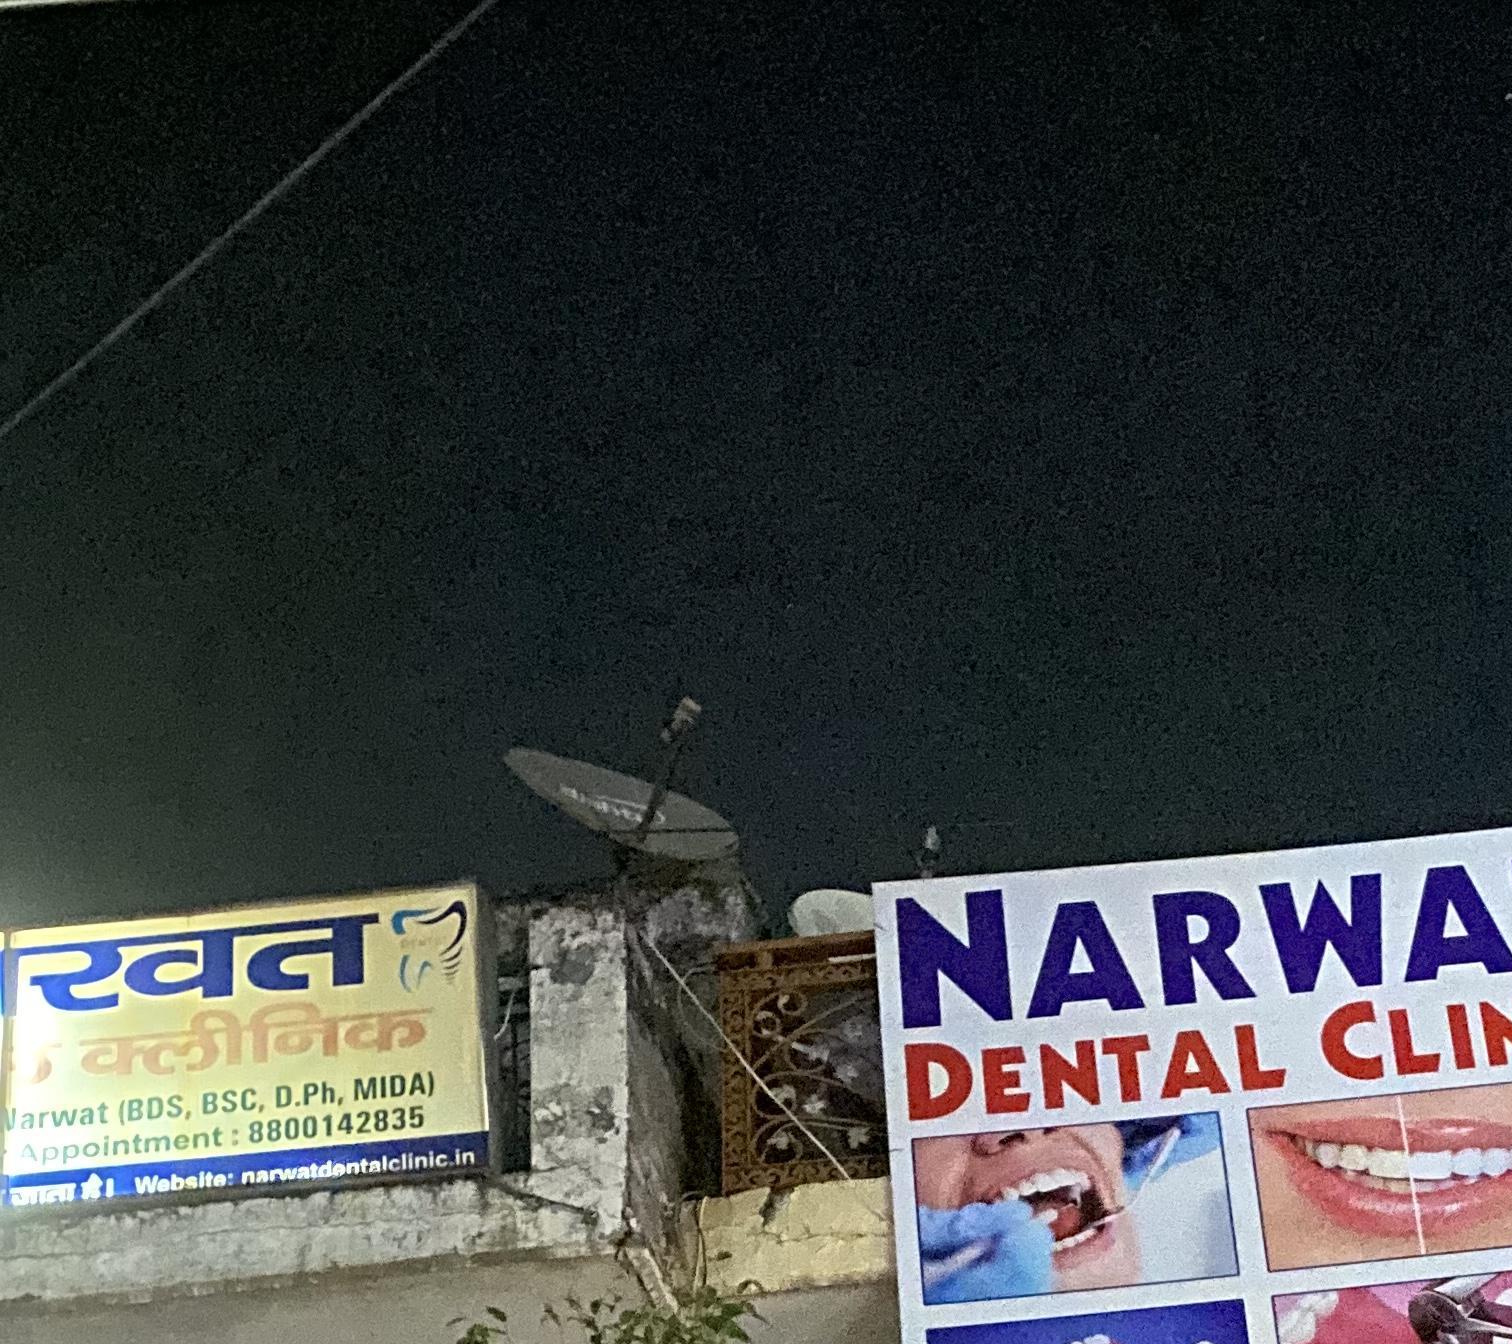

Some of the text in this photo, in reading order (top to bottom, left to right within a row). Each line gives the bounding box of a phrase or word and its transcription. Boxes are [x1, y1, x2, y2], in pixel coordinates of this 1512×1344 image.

[12, 913, 379, 1011] रवत
[81, 1002, 435, 1076] क्लीनिक
[119, 1094, 192, 1125] (BDS,
[202, 1087, 264, 1115] BSC,
[276, 1081, 344, 1108] D.Ph,
[354, 1071, 435, 1101] MIDA)
[903, 1023, 1285, 1122] DENTAL
[20, 1127, 223, 1165] Appointment
[249, 1106, 424, 1143] 8800142835
[134, 1149, 475, 1194] Website: narwatdentalclinic.in
